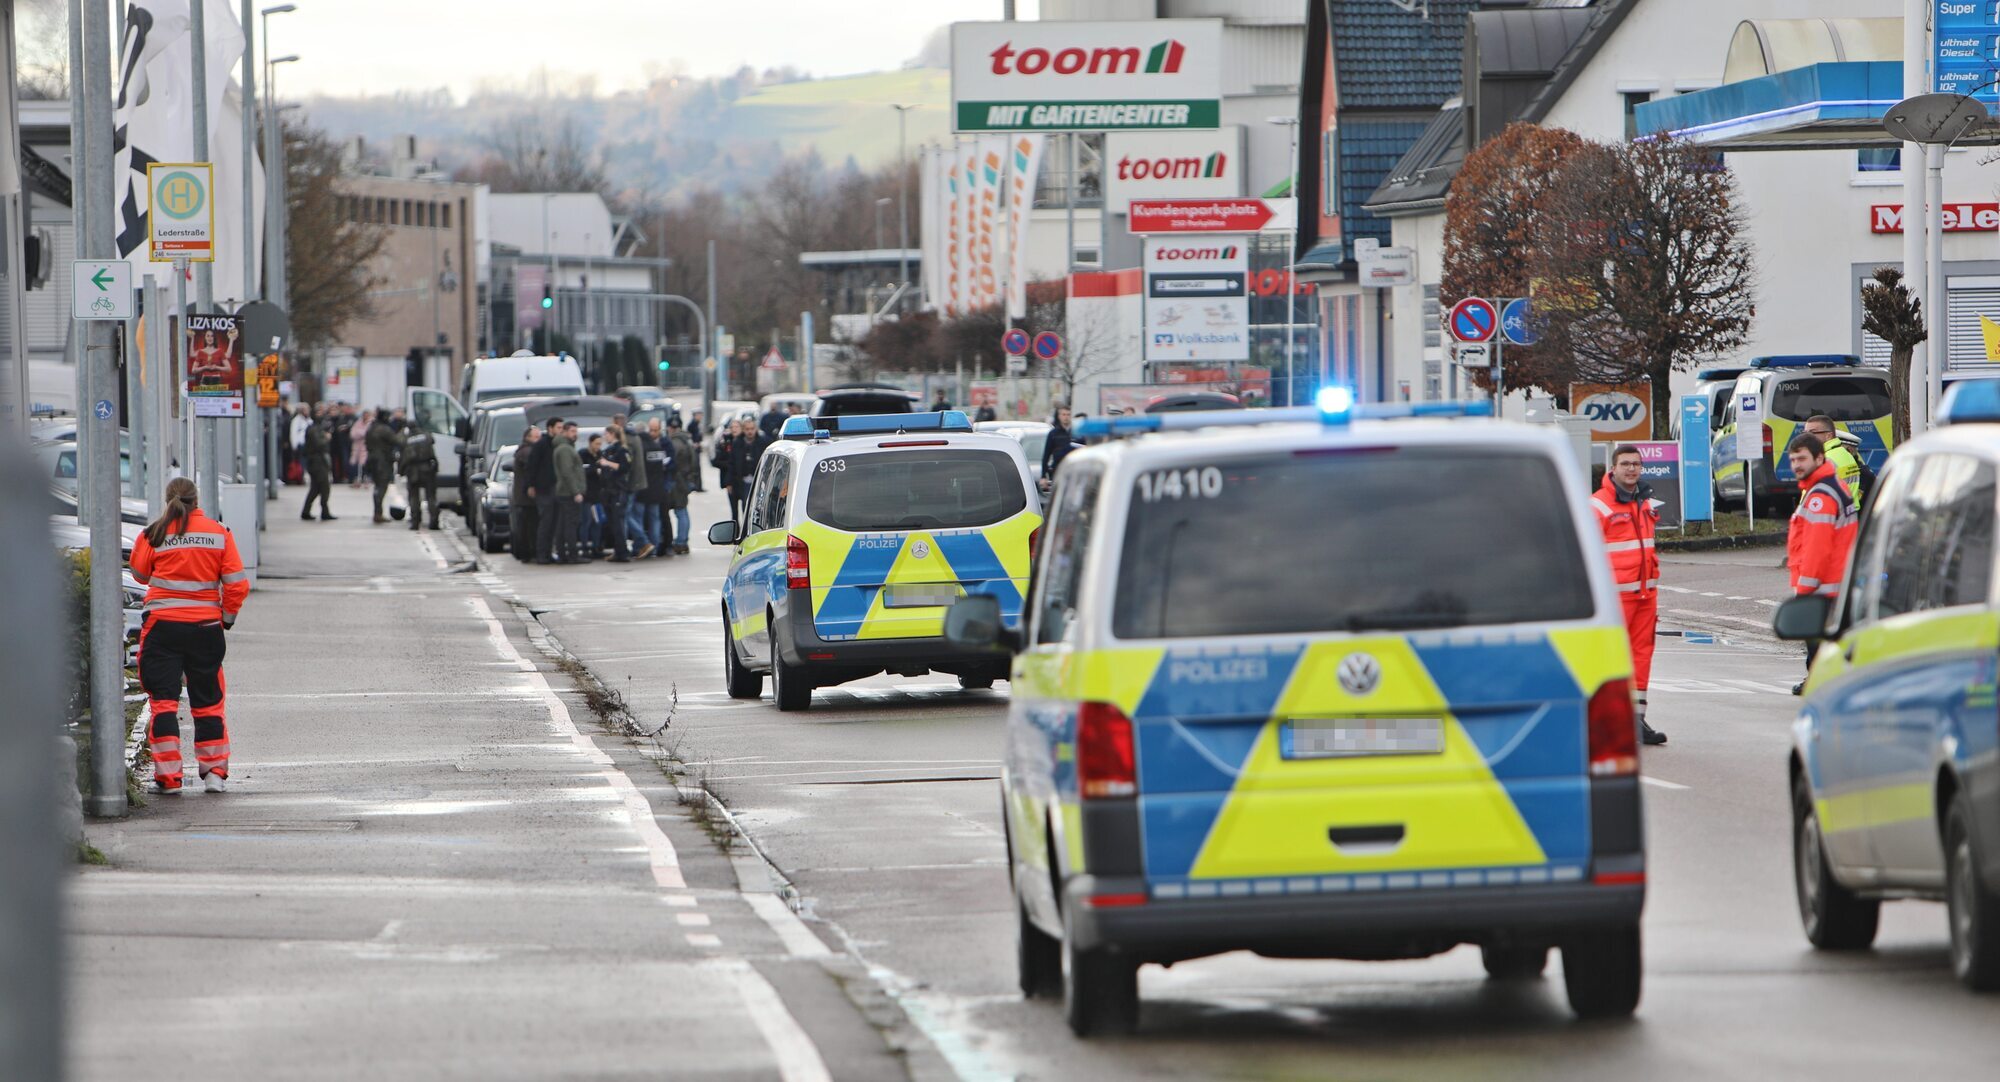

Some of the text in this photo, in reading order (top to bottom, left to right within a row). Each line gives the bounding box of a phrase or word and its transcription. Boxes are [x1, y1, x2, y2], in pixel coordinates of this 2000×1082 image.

[1940, 3, 1976, 15] Super
[1940, 38, 1980, 47] ultimate
[990, 41, 1141, 74] toom
[1940, 72, 1980, 81] ultimate
[1940, 83, 1957, 91] 102
[987, 104, 1190, 126] MIT GARTENCENTER
[1118, 154, 1202, 180] toom
[1133, 203, 1258, 217] Kundenparkplatz
[1875, 205, 1999, 230] Mele
[1156, 246, 1218, 260] toom
[188, 316, 236, 330] LIZA KOS
[1177, 333, 1240, 344] Volksbank
[1777, 383, 1800, 391] 1/904
[1584, 403, 1641, 420] DKV
[1850, 425, 1874, 433] HUNDE
[819, 459, 846, 473] 933
[1137, 466, 1223, 502] 1/410
[859, 539, 899, 549] POLIZEI
[1170, 659, 1268, 682] POLIZEI
